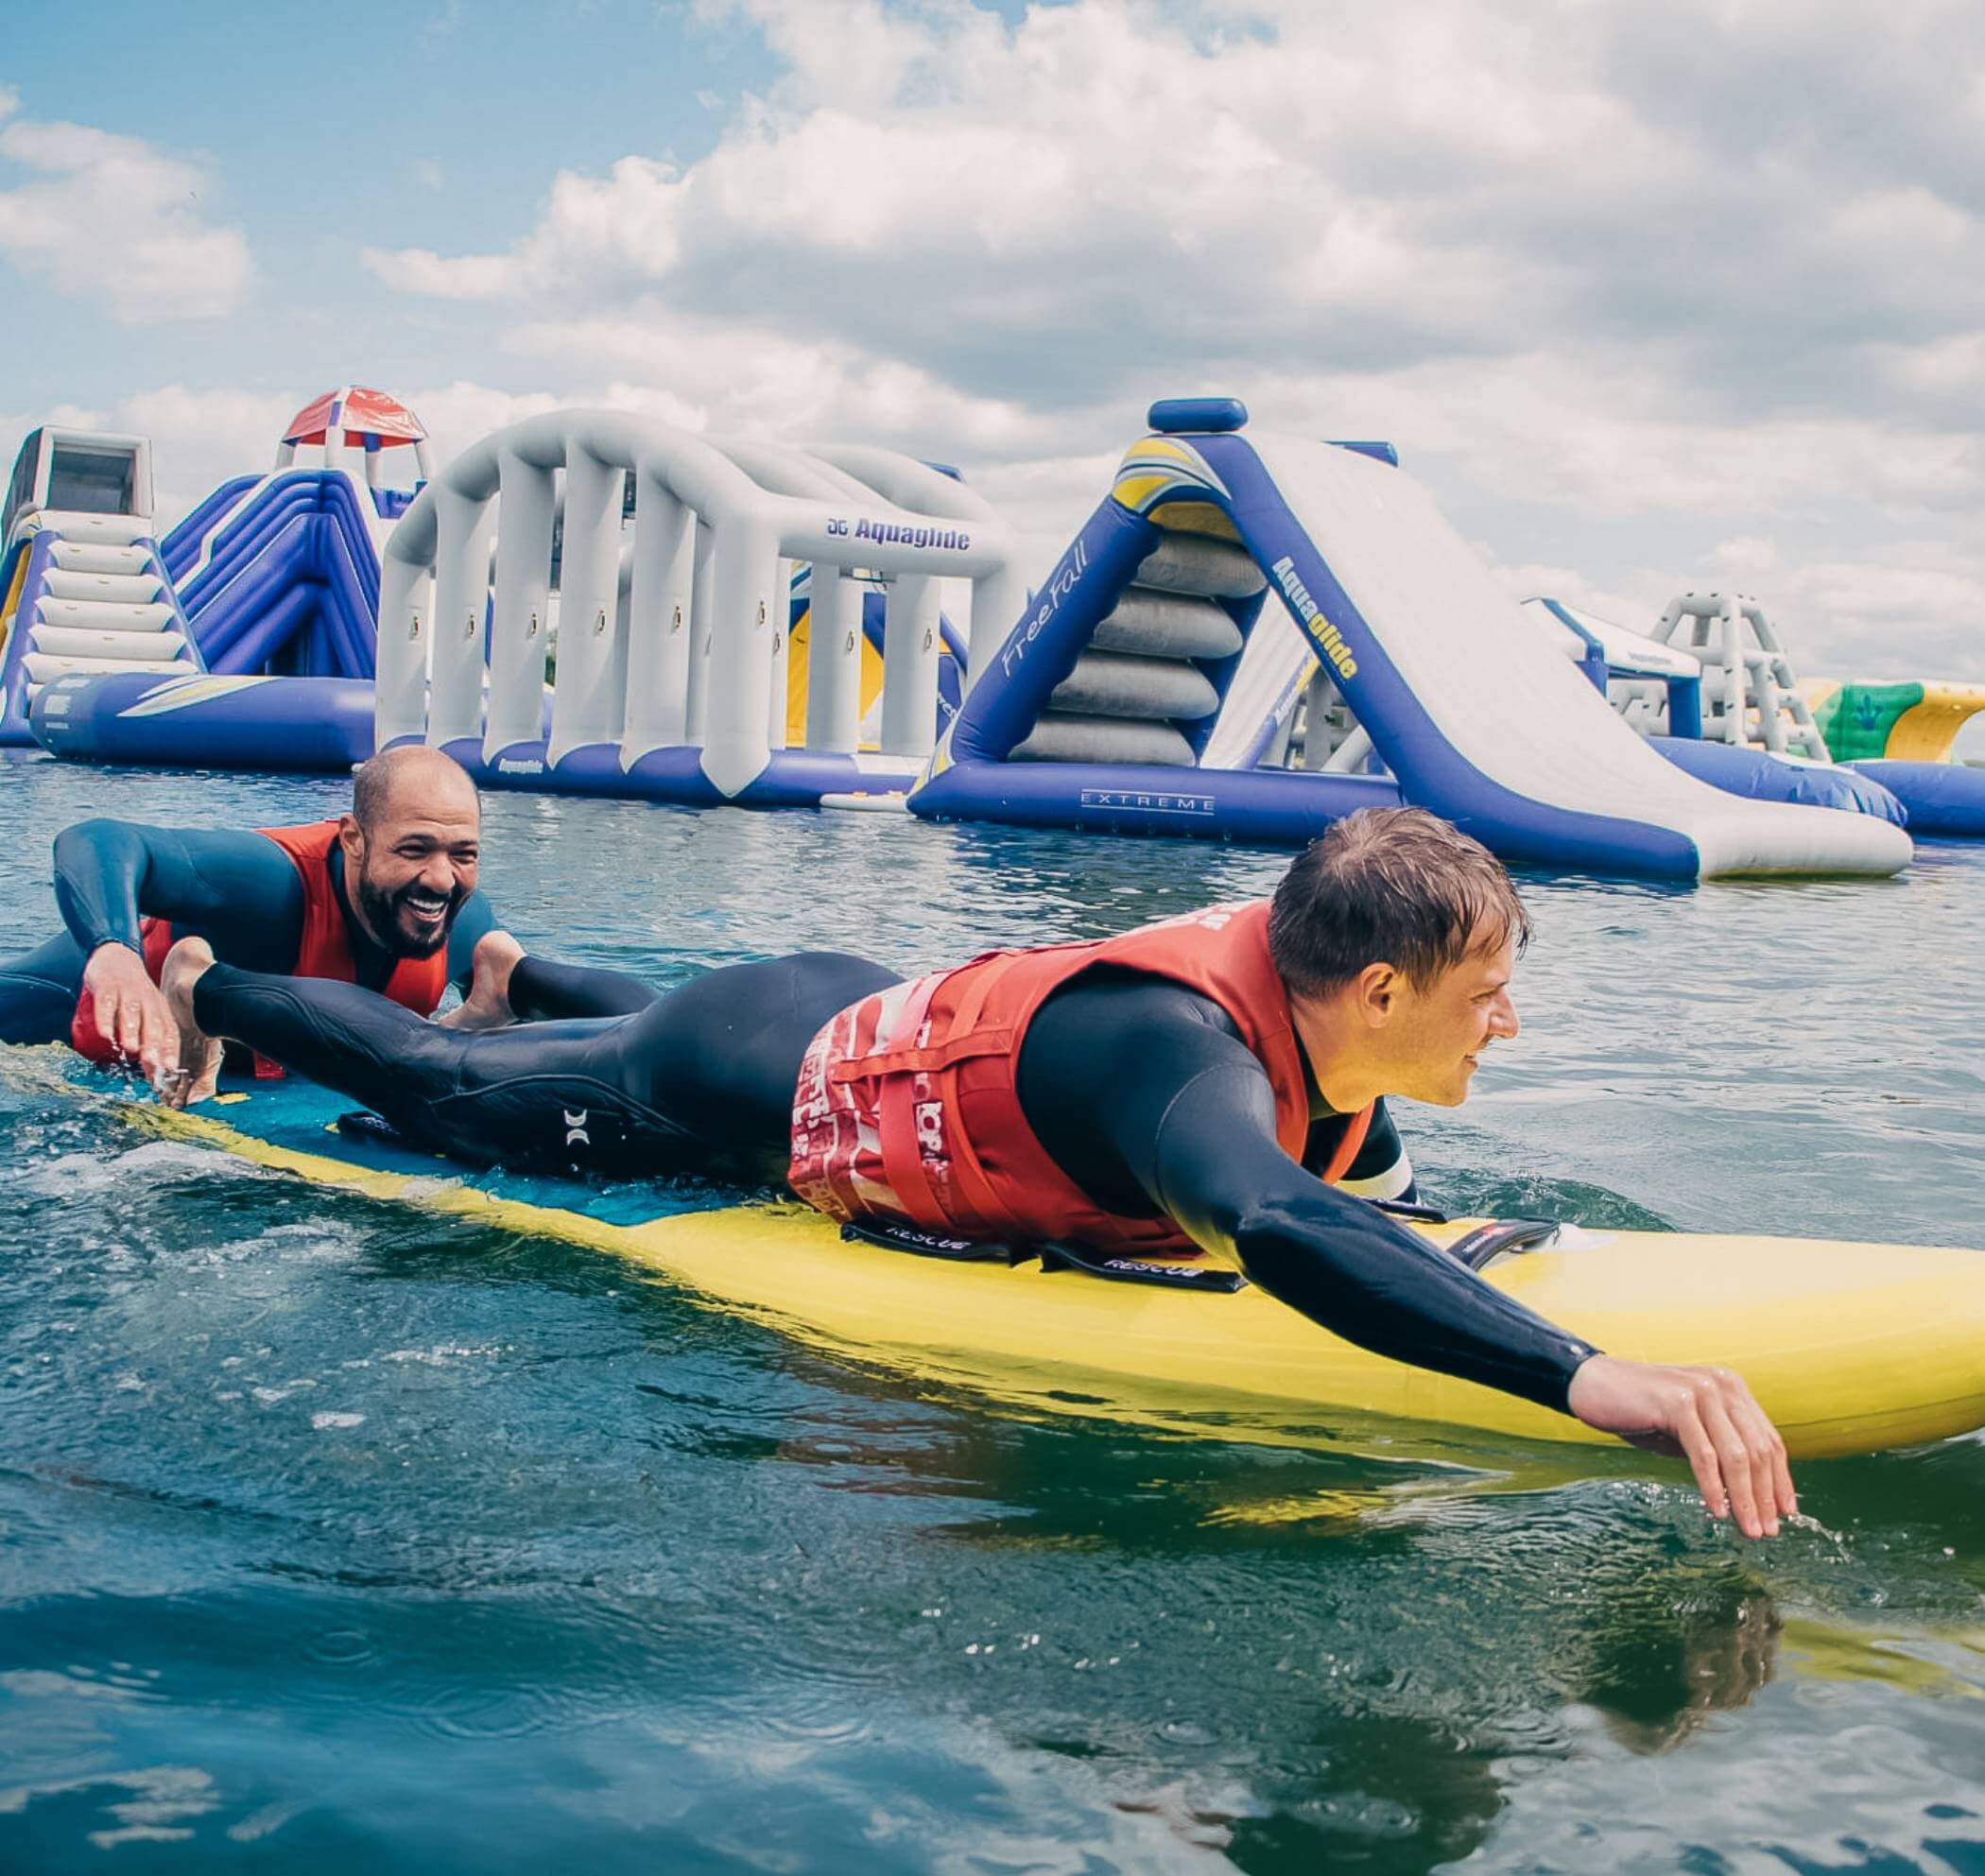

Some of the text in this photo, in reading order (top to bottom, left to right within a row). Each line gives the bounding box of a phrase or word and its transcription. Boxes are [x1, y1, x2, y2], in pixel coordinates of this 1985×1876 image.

[854, 518, 970, 550] Aquaglide
[1271, 555, 1358, 680] Aquaglide
[1080, 792, 1216, 811] EXTREME
